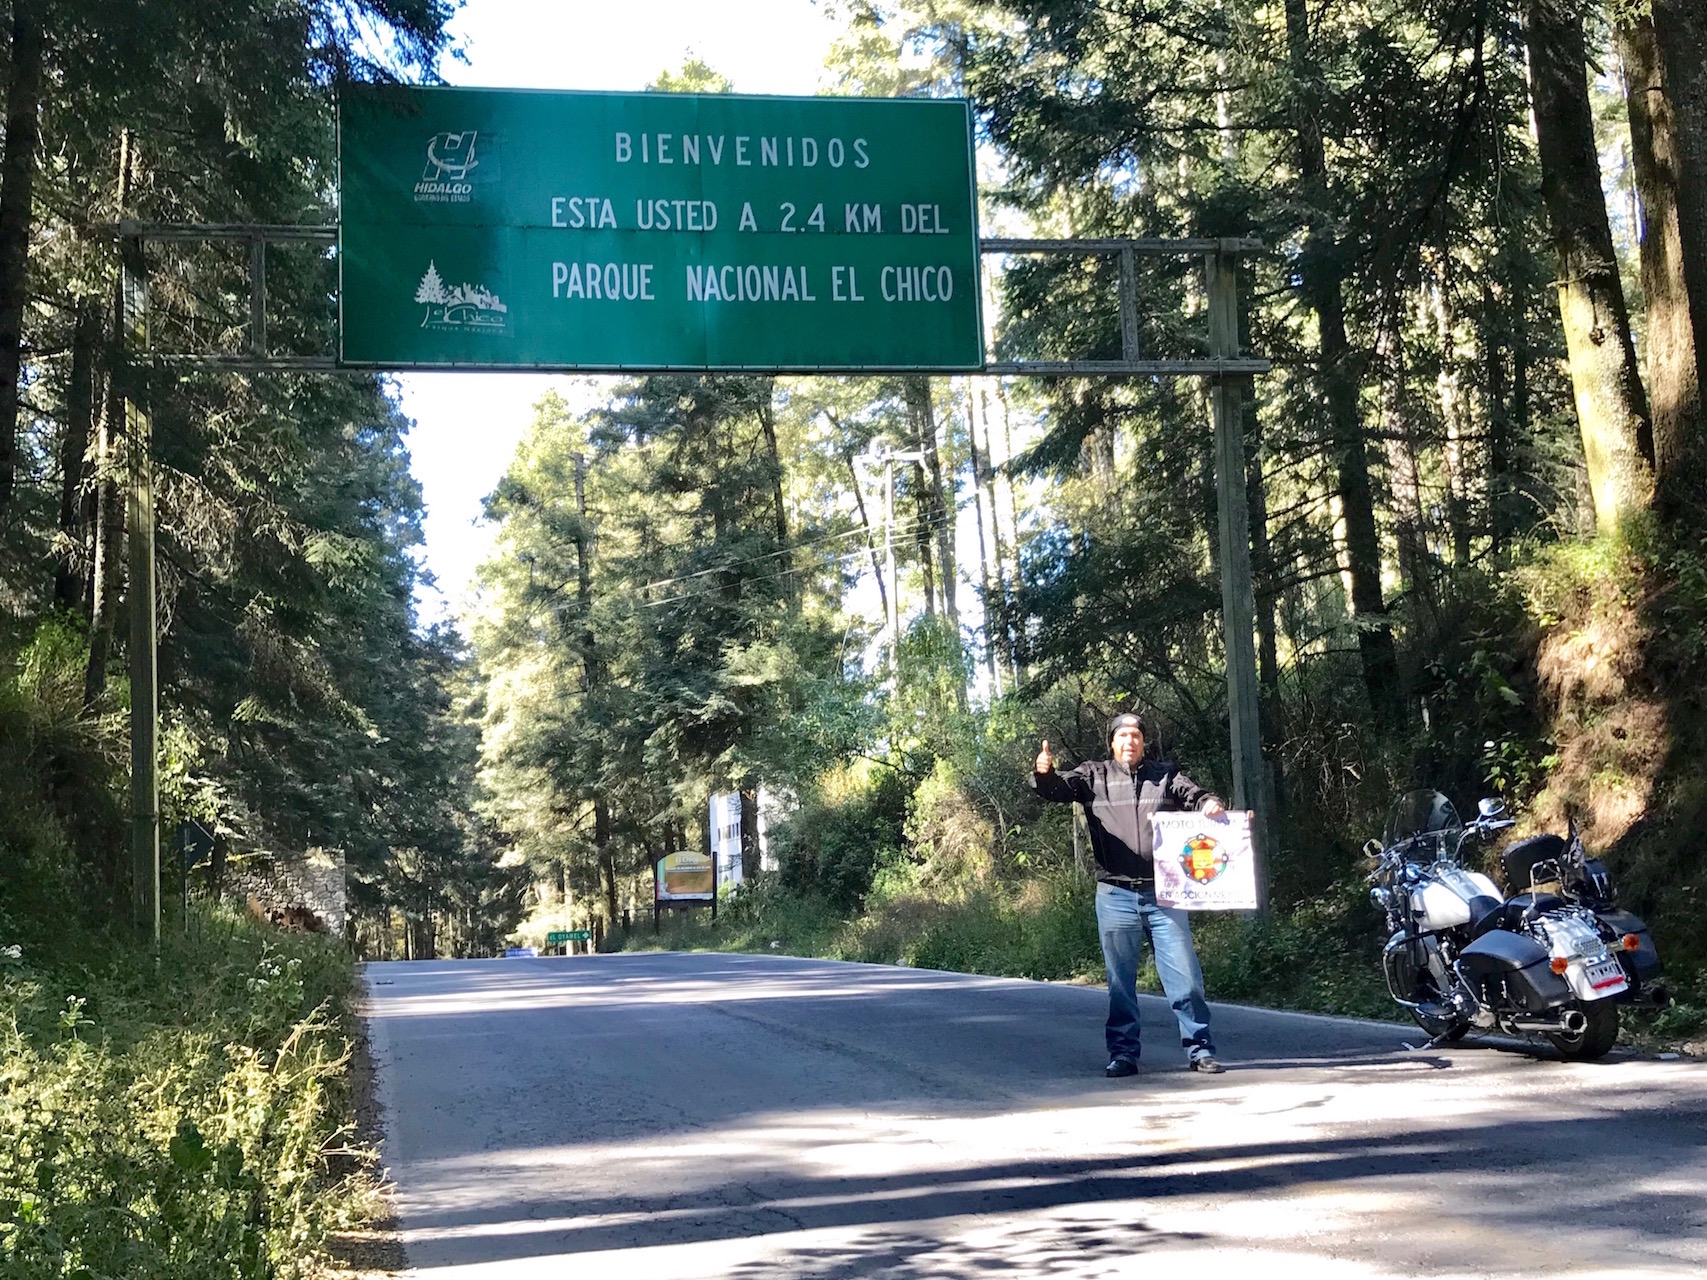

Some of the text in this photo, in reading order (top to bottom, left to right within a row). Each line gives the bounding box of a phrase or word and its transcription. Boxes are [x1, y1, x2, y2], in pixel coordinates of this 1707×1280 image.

[615, 132, 870, 169] BIENVENIDOS
[414, 182, 472, 194] HIDALGO
[551, 197, 949, 234] ESTA USTED A 2.4 KM DEL
[552, 262, 953, 302] PARQUE NACIONAL EL CHICO
[1161, 820, 1195, 829] MOTO
[1160, 890, 1172, 899] EN
